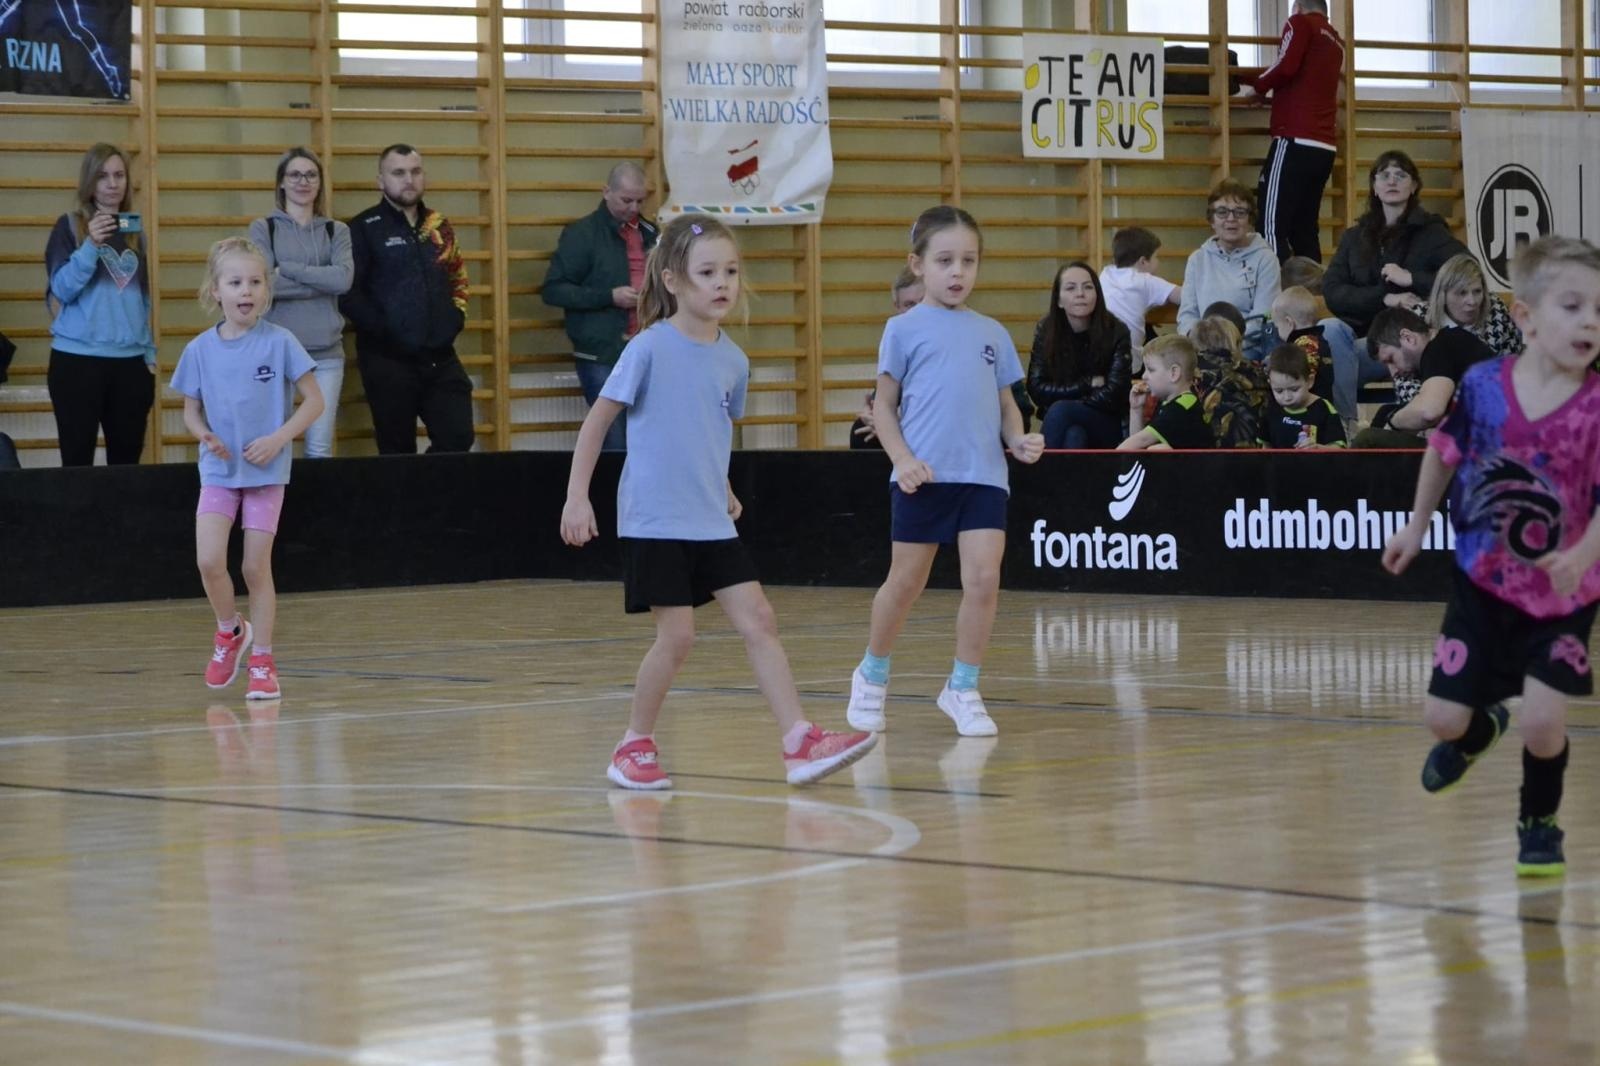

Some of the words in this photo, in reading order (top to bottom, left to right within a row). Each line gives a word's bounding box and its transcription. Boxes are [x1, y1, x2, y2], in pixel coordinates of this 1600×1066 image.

[684, 0, 729, 19] powiat
[6, 38, 62, 73] RZNA
[687, 61, 737, 86] MAŁY
[742, 63, 798, 88] SPORT
[1039, 52, 1155, 97] TEAM
[669, 97, 741, 123] WIELKA
[746, 96, 823, 125] RADOŚĆ
[1031, 97, 1159, 153] CITRUS
[1030, 519, 1178, 570] fontana
